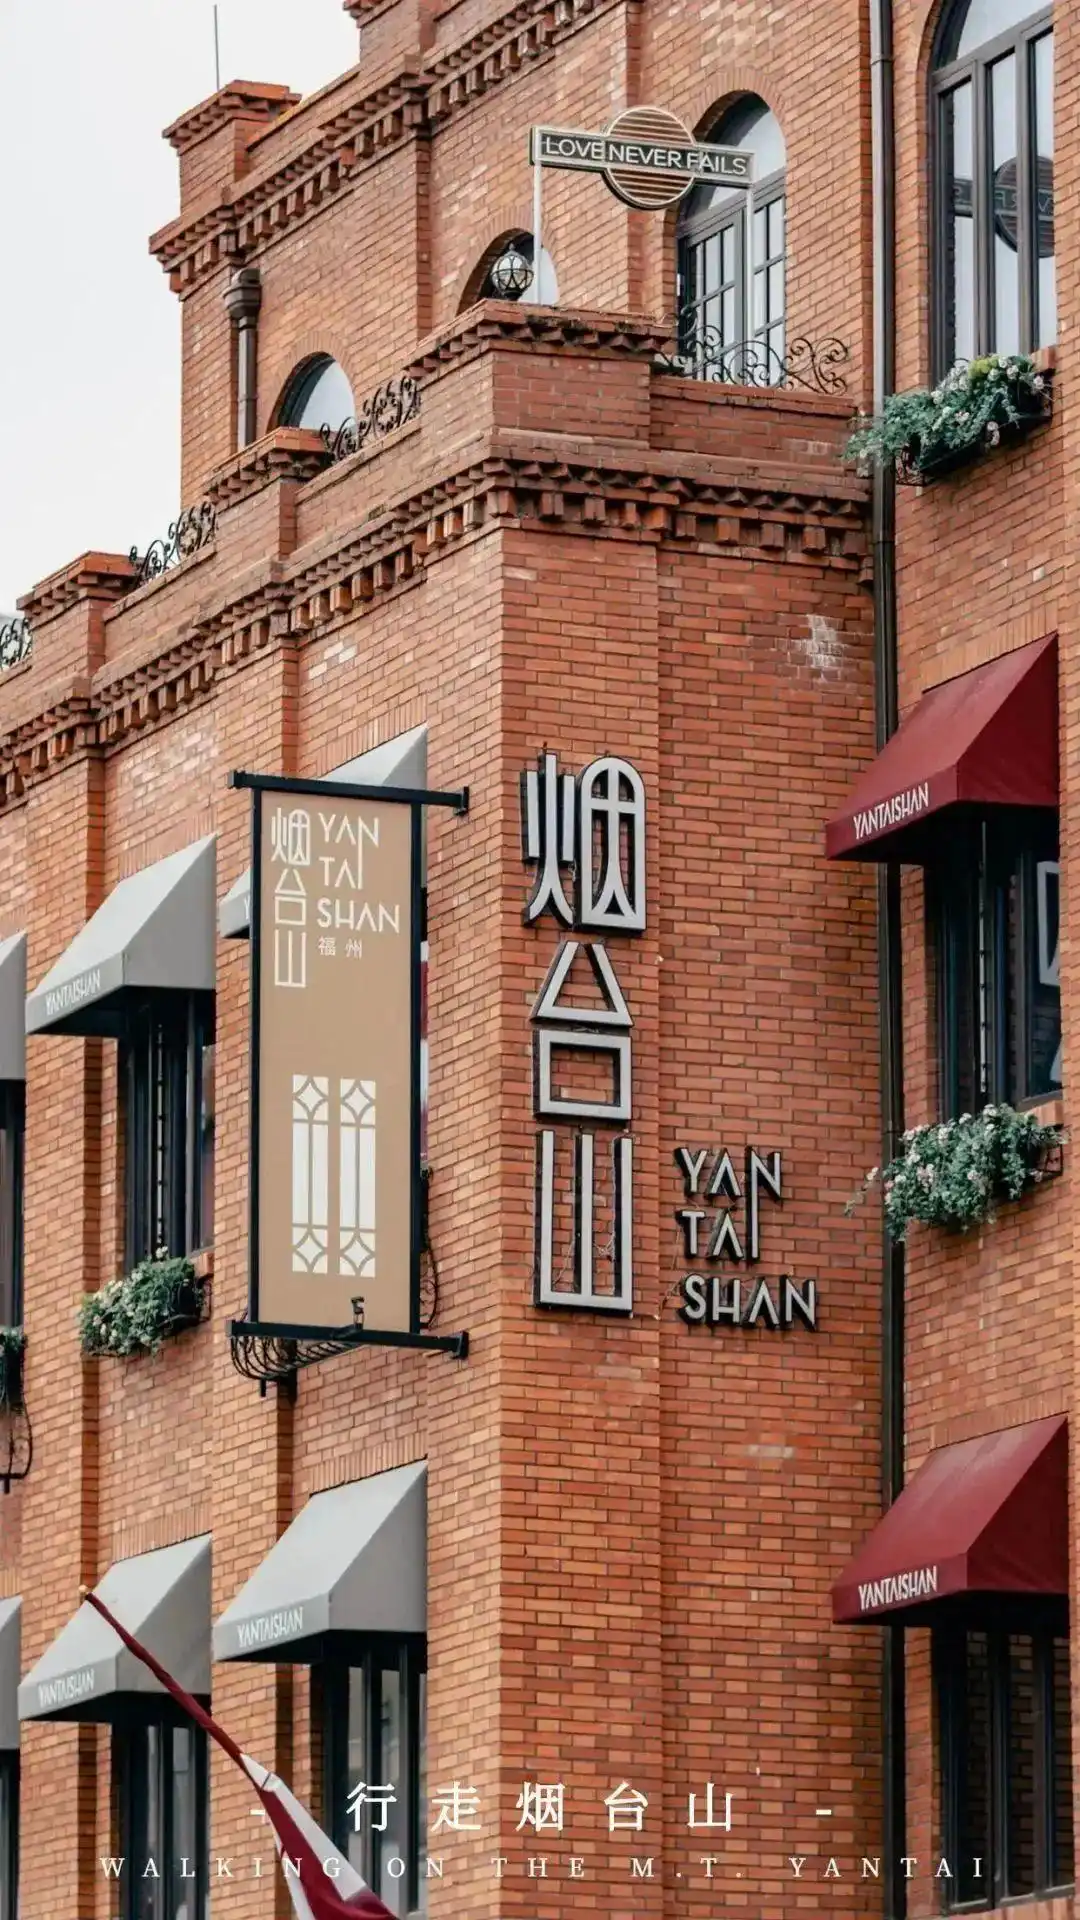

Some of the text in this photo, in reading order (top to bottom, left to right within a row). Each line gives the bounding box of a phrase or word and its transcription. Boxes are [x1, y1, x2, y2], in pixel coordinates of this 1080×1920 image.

[545, 137, 747, 176] LOVE NEVER FAILS
[317, 812, 380, 848] YAN
[852, 782, 930, 840] YANTAISHAN
[317, 856, 364, 890] TAI
[270, 807, 311, 988] 烟台山
[316, 897, 400, 934] SHAN
[317, 936, 364, 959] 福州
[44, 967, 101, 1017] YANTAISHAN
[520, 752, 646, 1312] 烟台山
[675, 1146, 783, 1202] YAN
[676, 1207, 760, 1262] TAI
[682, 1273, 817, 1329] SHAN
[857, 1565, 938, 1612] YANTAISHAN
[236, 1605, 304, 1649] YANTAISHAN
[37, 1667, 95, 1709] YANTAISHAN
